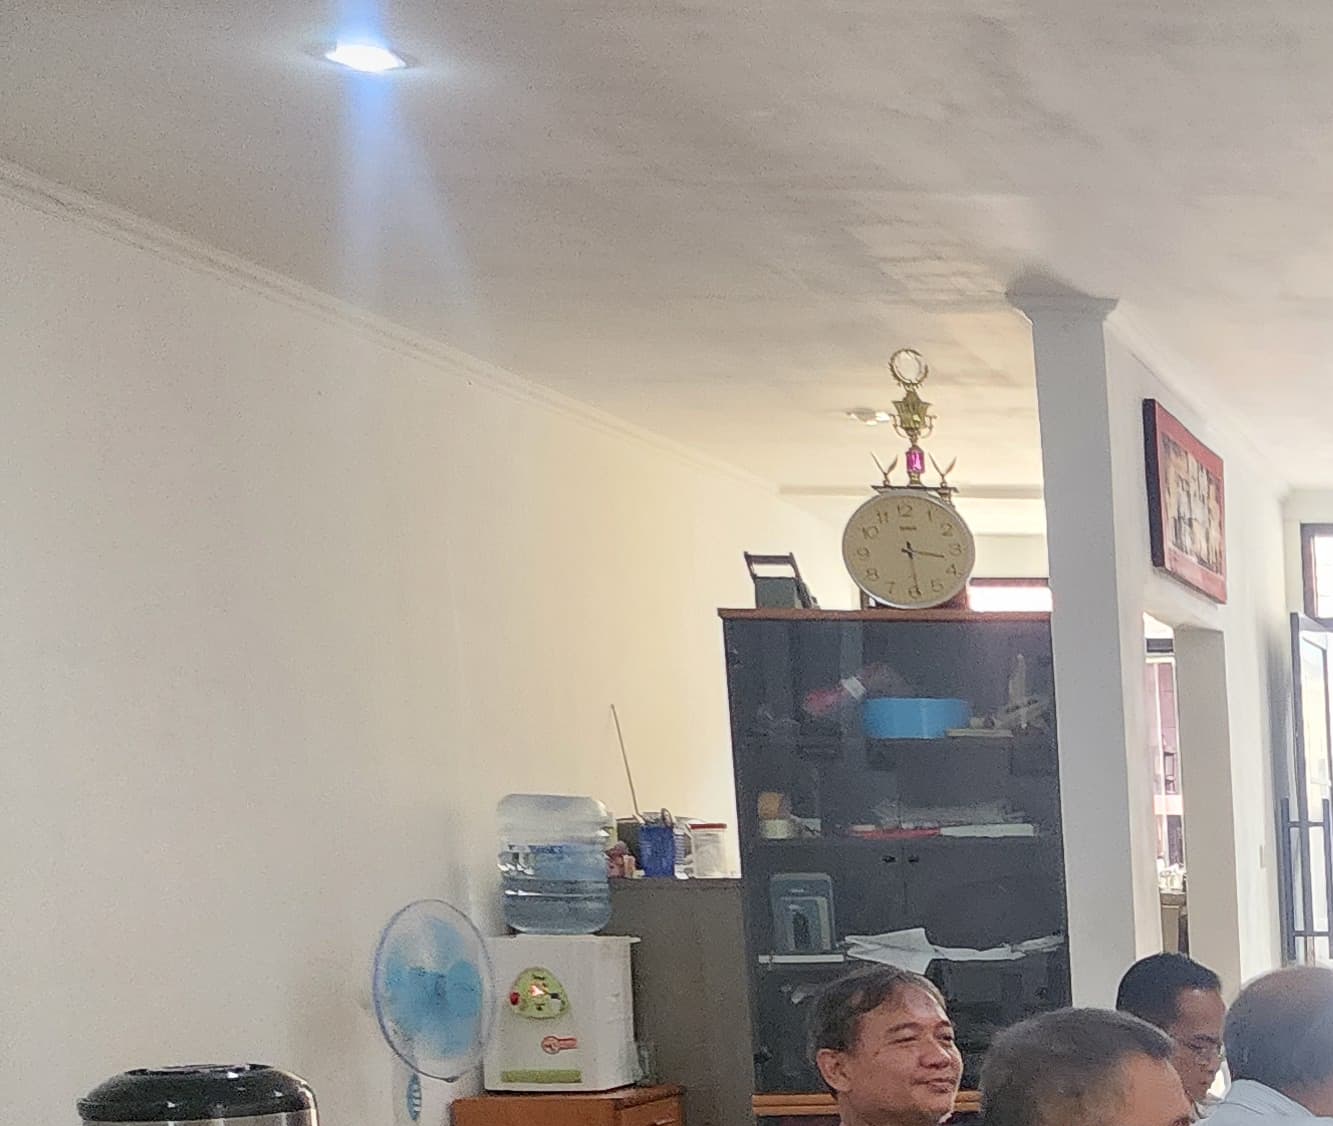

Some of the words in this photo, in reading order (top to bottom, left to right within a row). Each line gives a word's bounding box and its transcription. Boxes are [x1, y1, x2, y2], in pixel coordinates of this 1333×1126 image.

[877, 510, 889, 524] 11
[897, 504, 913, 518] 12
[862, 525, 879, 539] 10
[941, 522, 953, 537] 2
[856, 547, 870, 561] 9
[948, 542, 962, 557] 3
[865, 567, 879, 581] 8
[945, 563, 957, 577] 4
[886, 581, 895, 594] 7
[908, 585, 922, 600] 6
[930, 579, 944, 592] 5
